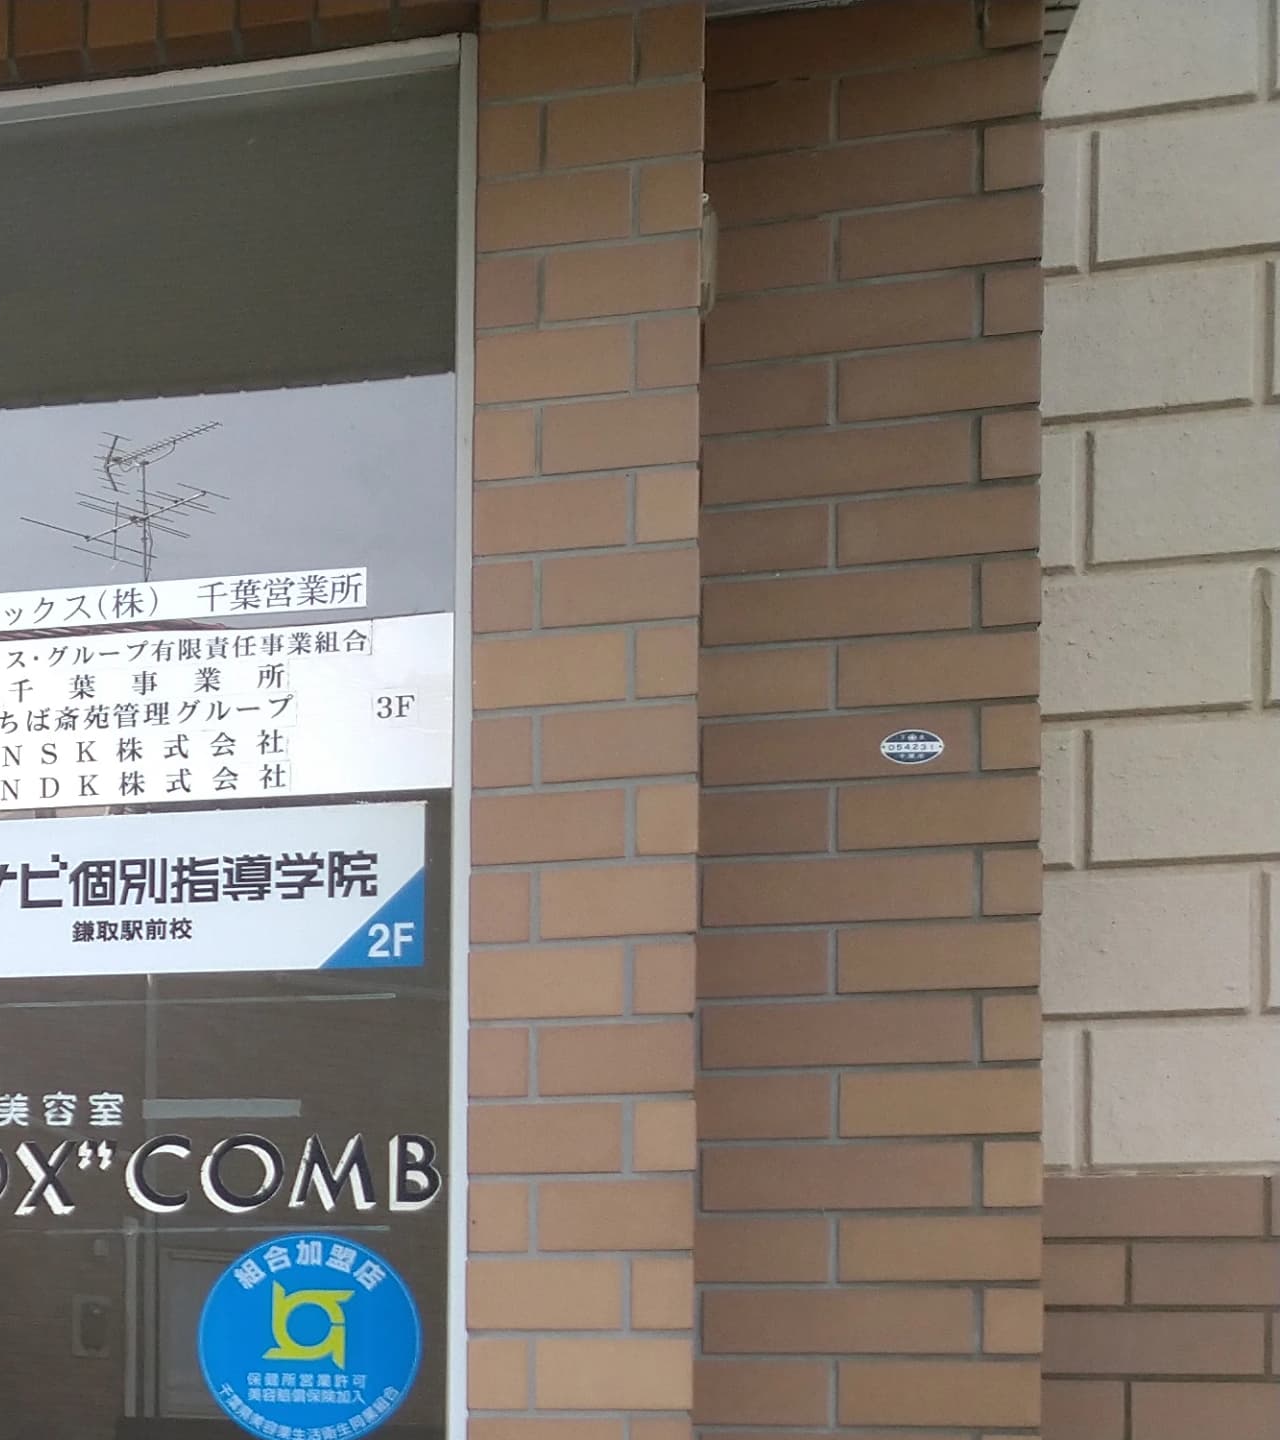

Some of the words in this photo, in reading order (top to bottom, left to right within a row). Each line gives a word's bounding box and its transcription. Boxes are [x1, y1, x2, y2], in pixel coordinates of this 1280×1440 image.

[197, 571, 364, 613] 千葉営業所
[9, 664, 286, 702] 千葉事業所
[376, 695, 415, 720] 3F
[72, 918, 193, 942] 鎌取駅前校
[368, 921, 414, 959] 2F
[233, 1240, 387, 1292] 組合加盟店
